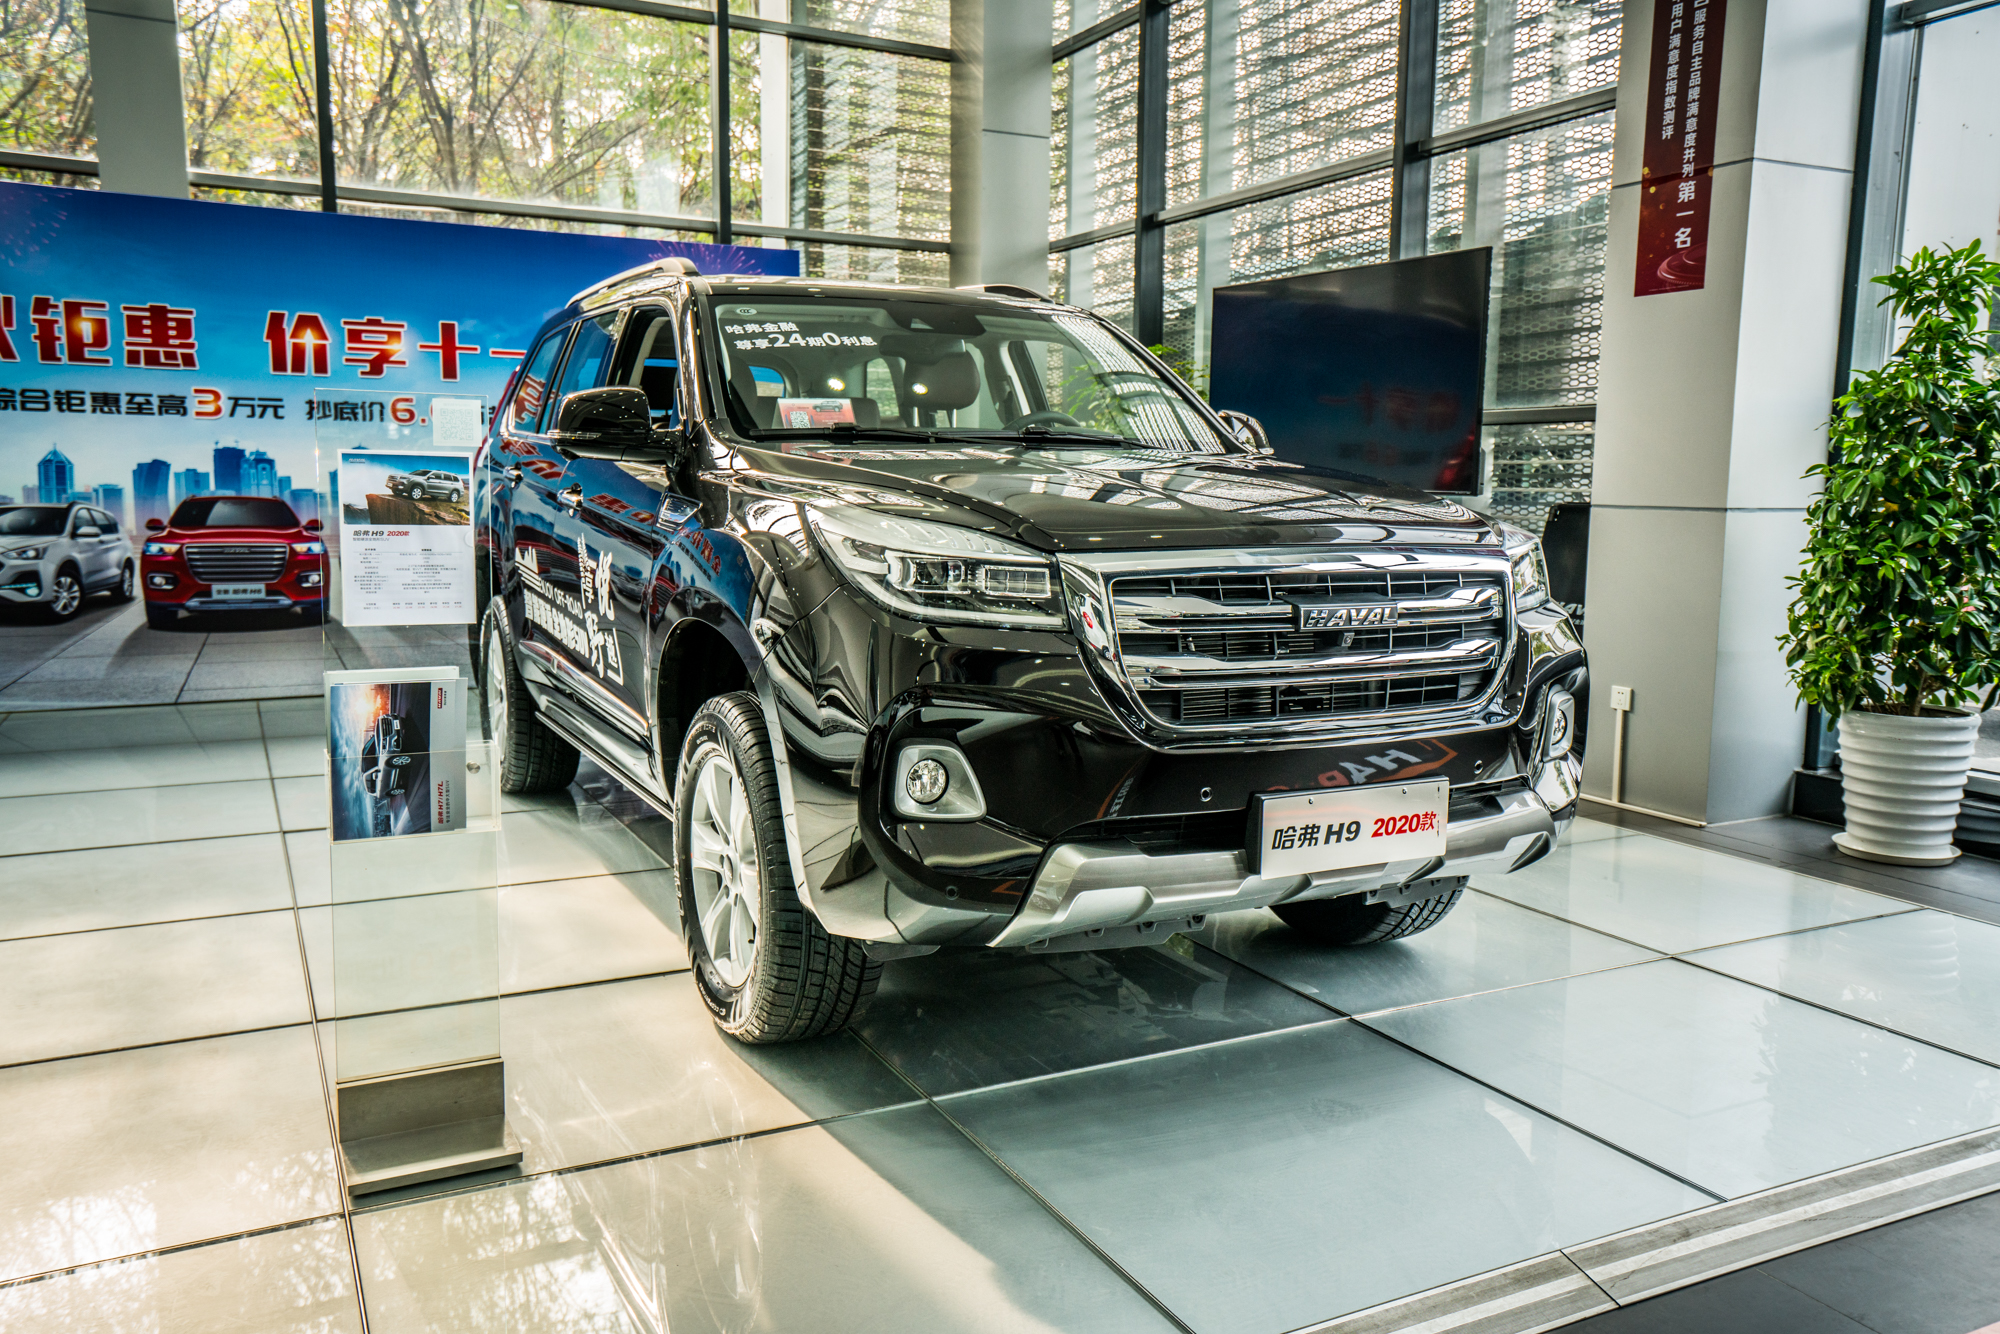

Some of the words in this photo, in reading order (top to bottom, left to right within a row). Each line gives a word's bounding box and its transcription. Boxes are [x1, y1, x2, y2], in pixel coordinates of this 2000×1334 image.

[1661, 0, 1684, 140] 用户满意度指数测评
[725, 322, 799, 335] 哈弗金融
[734, 332, 878, 351] 尊享24期0利息
[1306, 607, 1395, 627] HAVAL
[1271, 820, 1361, 851] 哈弗H9
[1371, 811, 1437, 838] 2020款
